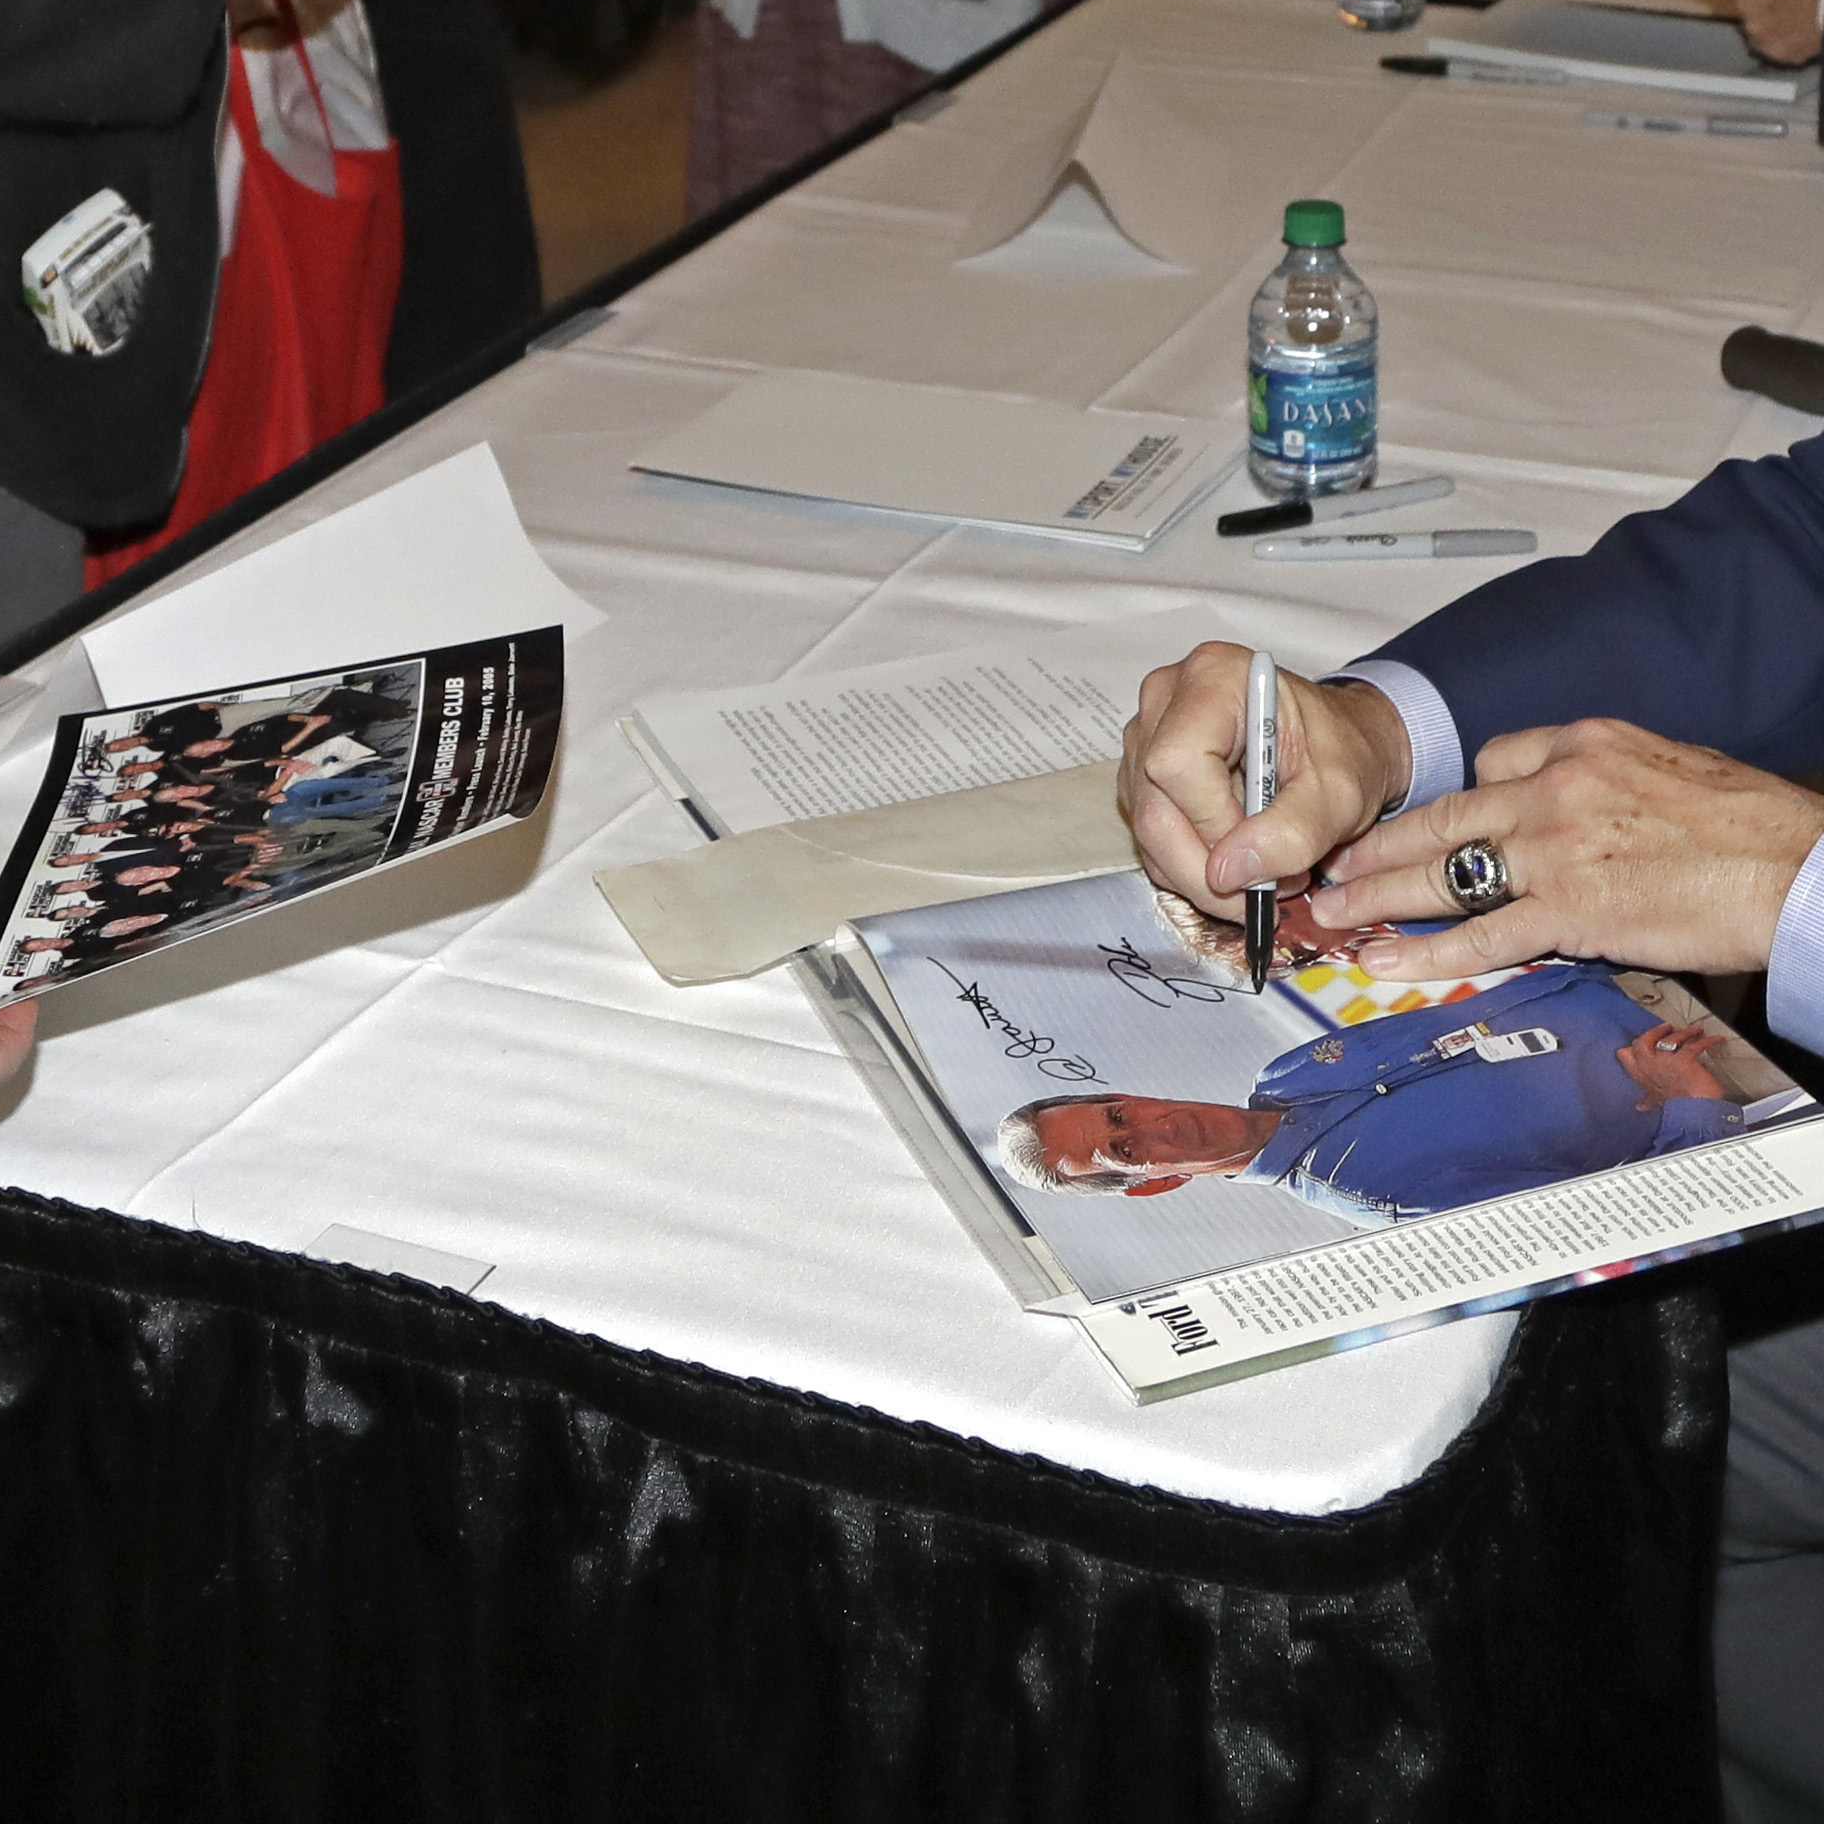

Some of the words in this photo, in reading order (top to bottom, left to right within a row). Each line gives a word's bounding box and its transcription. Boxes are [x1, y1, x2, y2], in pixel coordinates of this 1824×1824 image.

[442, 676, 466, 717] CLUB
[482, 666, 495, 691] 2005
[476, 708, 495, 741] February
[431, 719, 462, 780] MEMBERS
[412, 797, 447, 839] NASCAR
[1147, 1304, 1220, 1356] Ford
